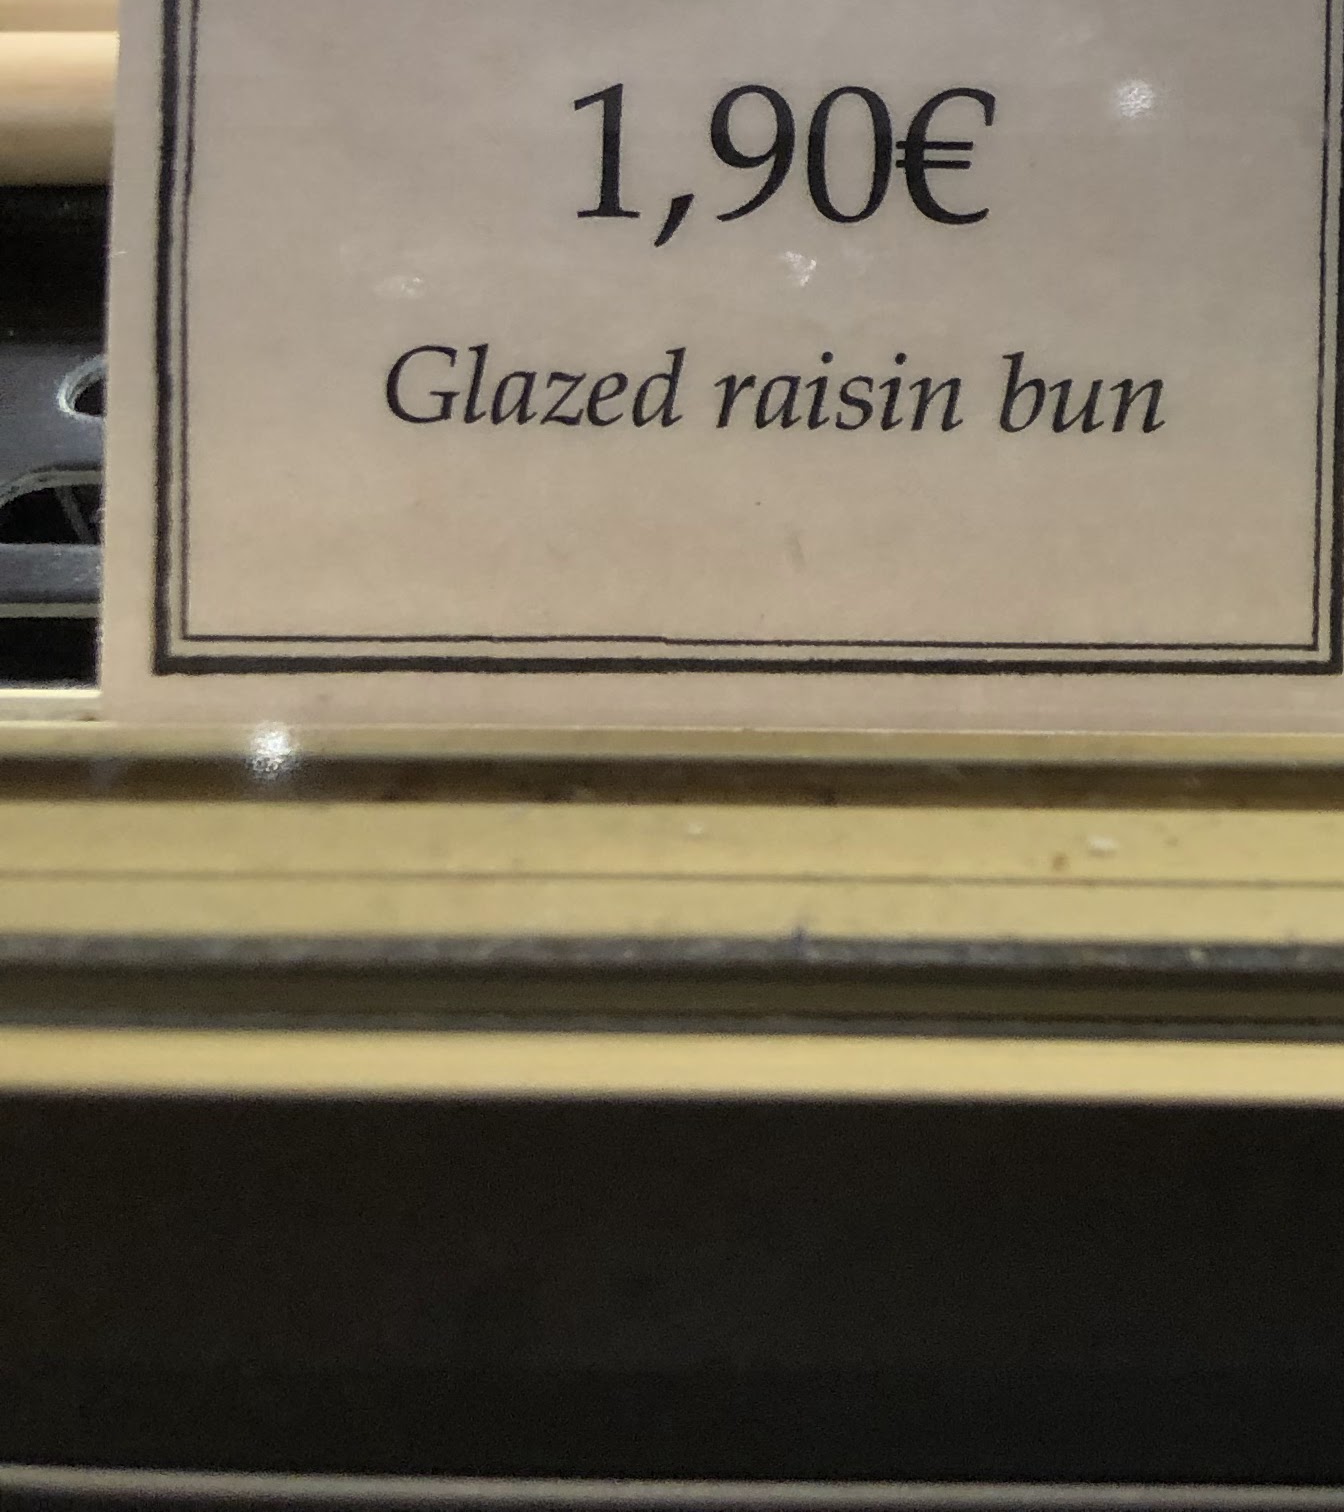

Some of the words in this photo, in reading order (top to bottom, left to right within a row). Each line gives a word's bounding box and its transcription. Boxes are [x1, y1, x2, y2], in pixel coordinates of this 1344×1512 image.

[573, 82, 996, 248] 1,90€
[385, 341, 688, 430] Glazed
[712, 350, 965, 433] raisin
[998, 349, 1167, 436] bun
